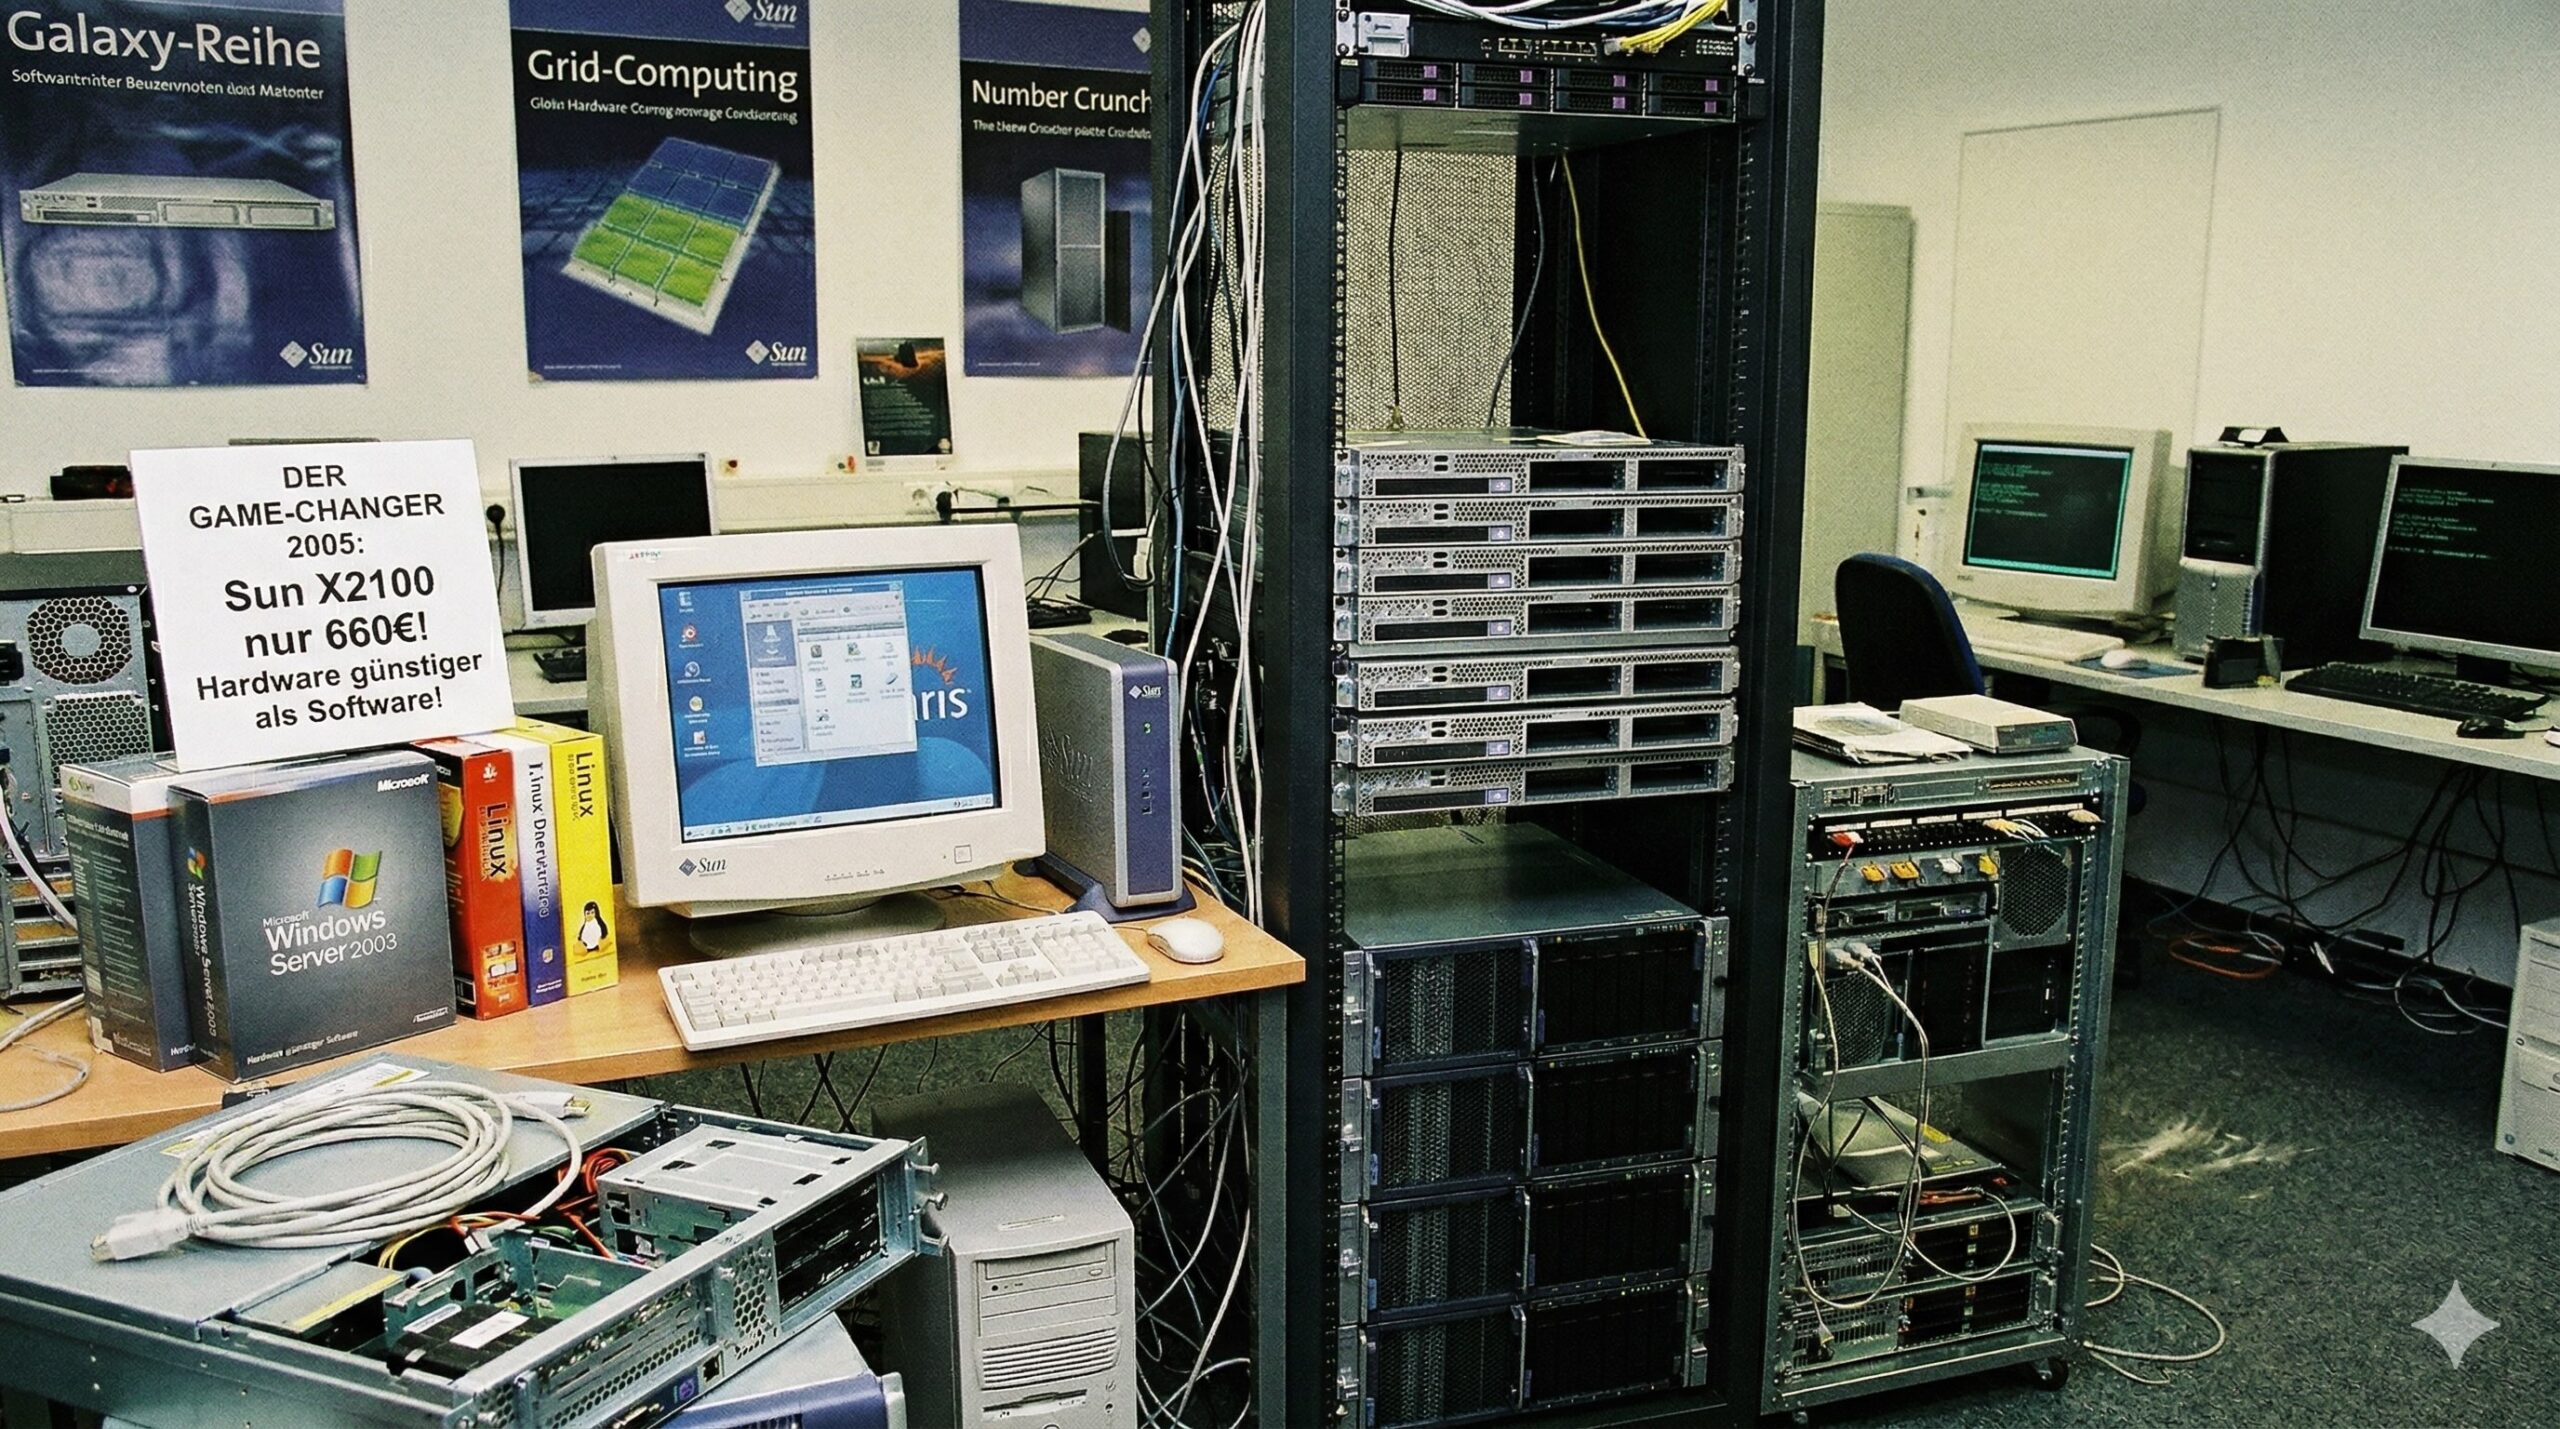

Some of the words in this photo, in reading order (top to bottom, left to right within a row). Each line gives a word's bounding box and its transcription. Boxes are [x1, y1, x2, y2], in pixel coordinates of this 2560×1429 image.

[753, 0, 797, 22] Sun
[8, 10, 321, 72] Galaxy-Reihe
[528, 49, 798, 103] Grid-Computing
[972, 79, 1069, 109] Number
[567, 98, 628, 114] Hardware
[309, 342, 352, 365] Sun
[769, 341, 807, 361] Sun
[283, 464, 347, 489] DER
[189, 493, 446, 529] GAME-CHANGER
[287, 532, 364, 558] 2005:
[224, 579, 304, 612] Sun
[315, 566, 434, 605] X2100
[245, 628, 312, 658] nur
[325, 611, 428, 650] 660€!
[197, 668, 340, 700] Hardware
[351, 653, 483, 690] günstiger
[256, 705, 298, 729] als
[308, 686, 443, 723] Software!
[576, 752, 595, 818] Linux
[486, 803, 508, 877] Linux
[697, 857, 726, 873] Sun
[263, 910, 311, 928] Microsoft
[265, 910, 387, 952] Windows
[270, 943, 347, 976] Server
[350, 932, 398, 960] 2003
